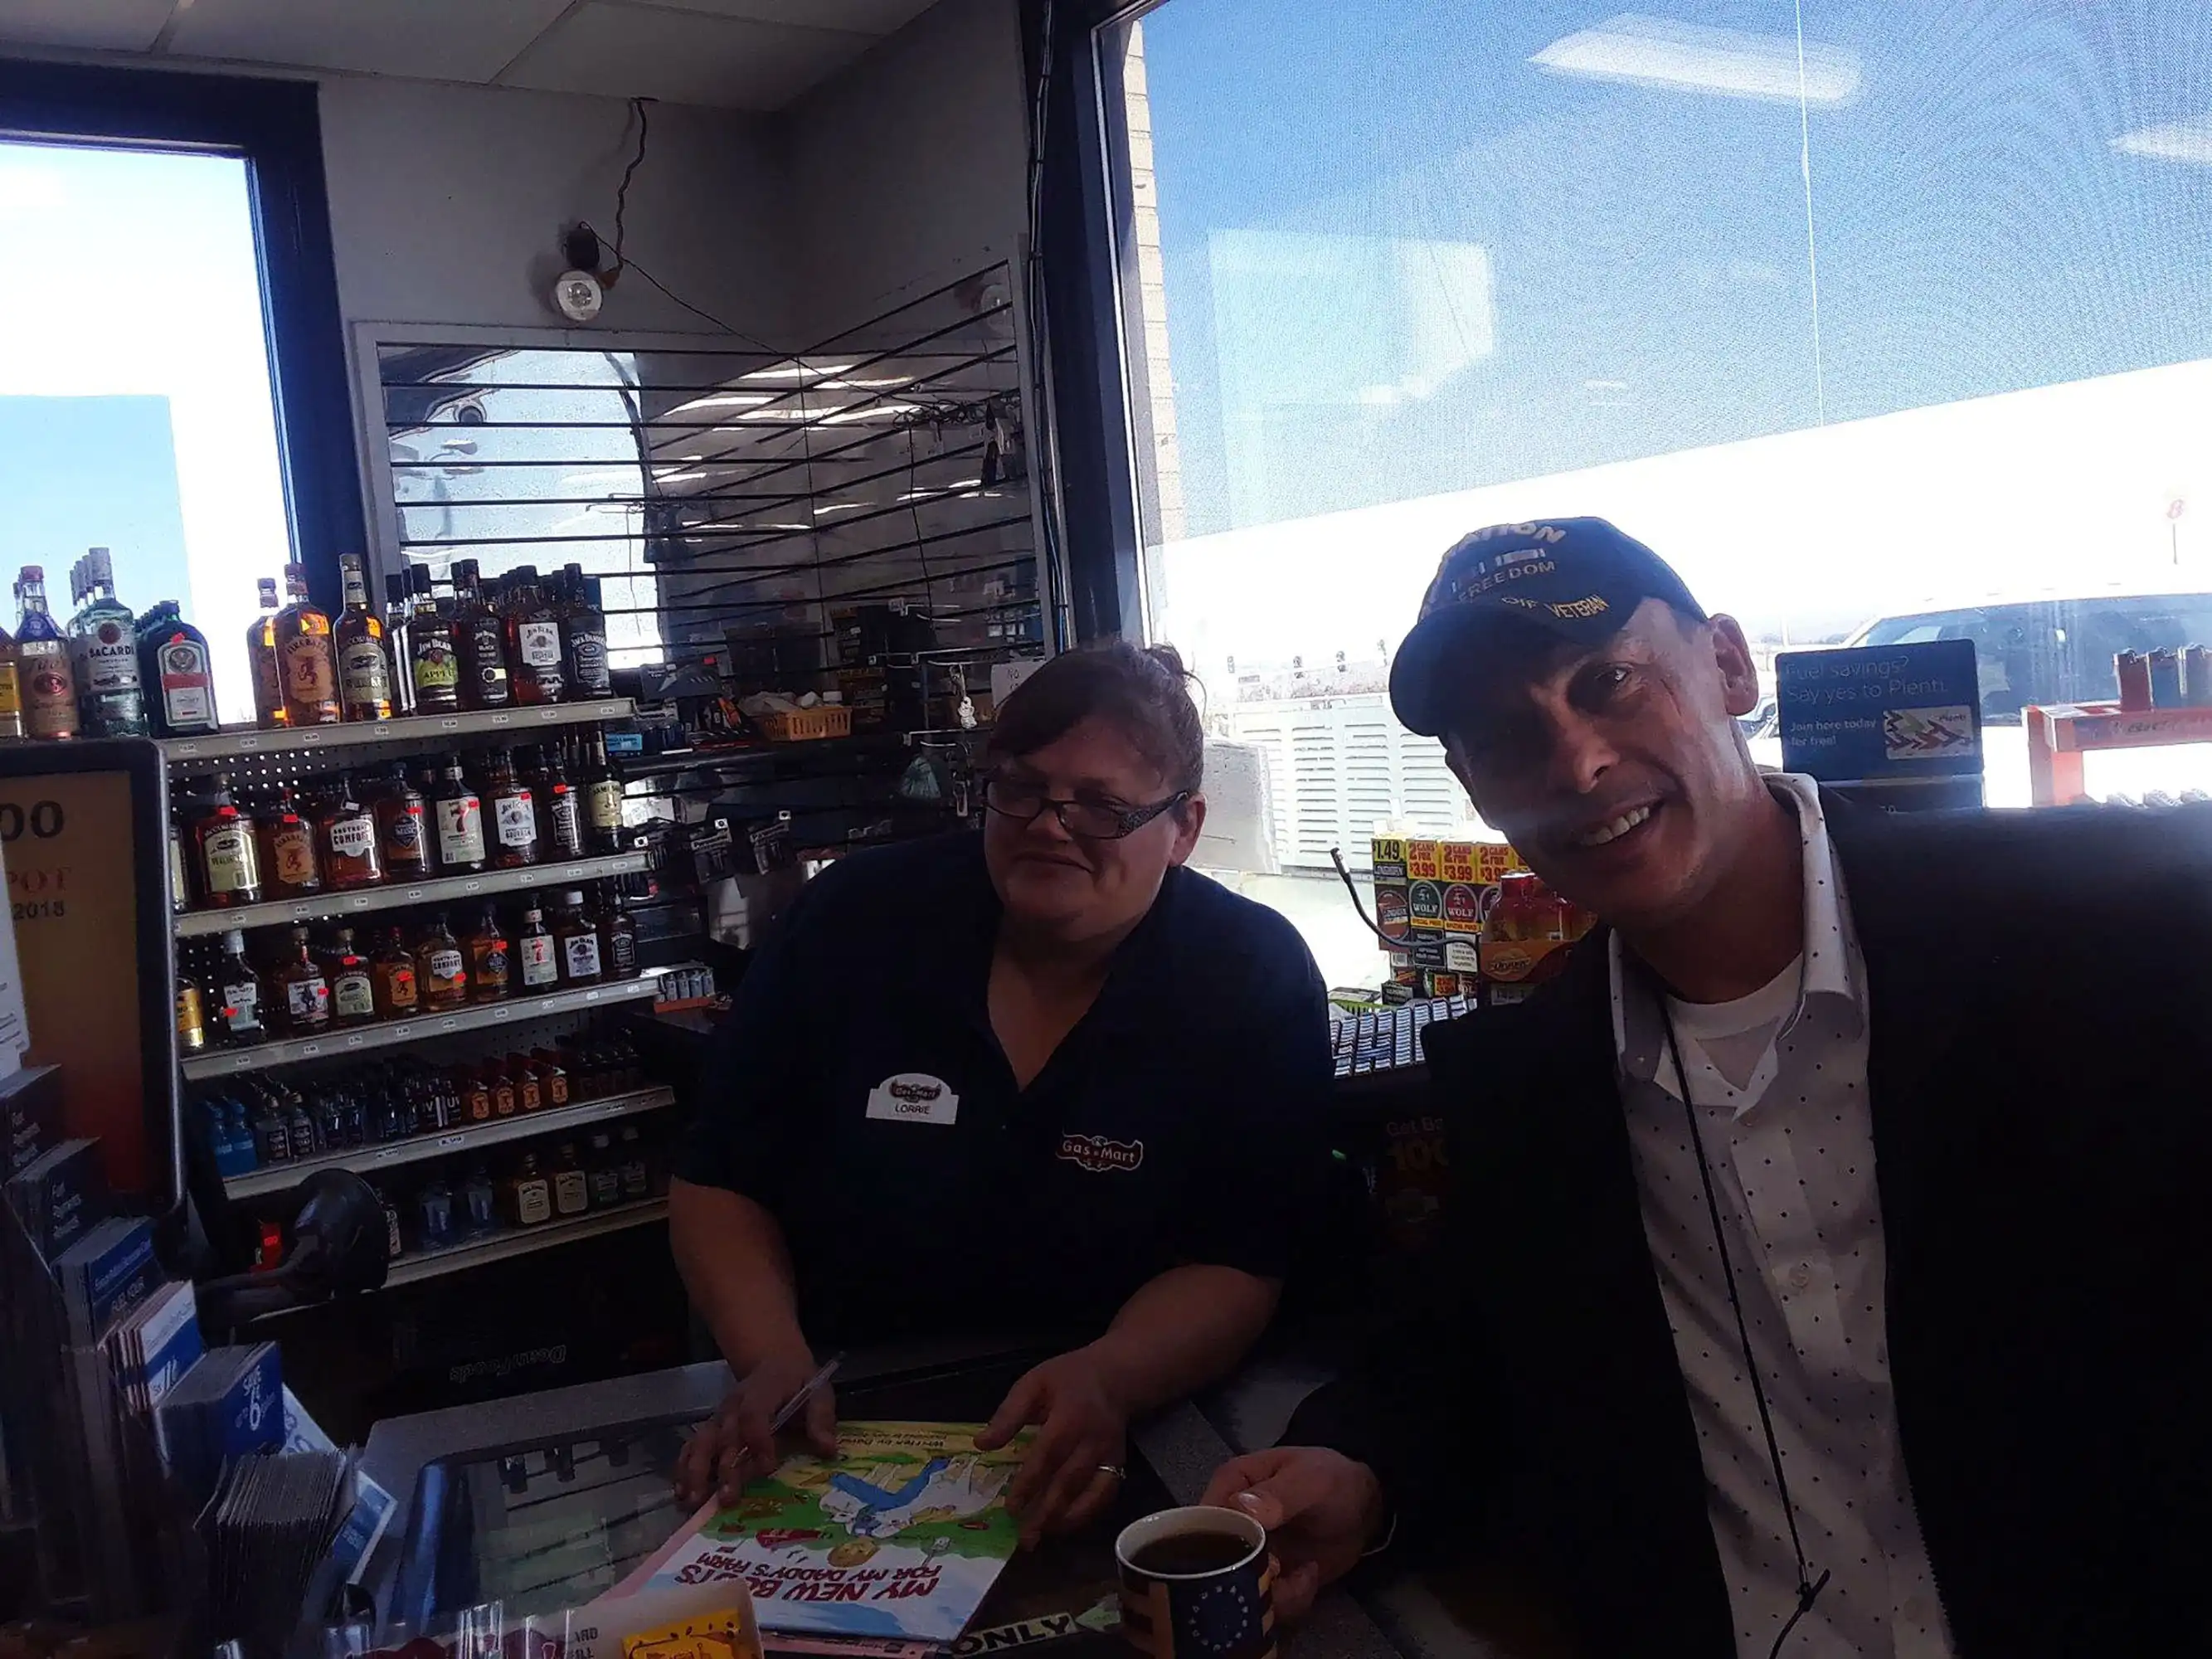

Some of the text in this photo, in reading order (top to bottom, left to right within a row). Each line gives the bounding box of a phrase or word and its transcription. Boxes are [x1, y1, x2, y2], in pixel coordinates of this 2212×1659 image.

[1458, 560, 1556, 603] FREEDOM
[1544, 594, 1609, 618] VETERAN
[89, 645, 134, 658] BACARDI
[418, 640, 432, 654] JIM
[1786, 654, 1910, 679] Fuel savings?
[1787, 685, 1821, 705] Say
[1825, 686, 1858, 704] yes
[1863, 682, 1883, 698] to
[1790, 717, 1877, 732] Join here today
[1791, 734, 1837, 748] for free!
[450, 805, 469, 833] 7
[333, 832, 371, 845] COMFORT
[1373, 840, 1399, 860] $1.49
[1409, 843, 1436, 860] 2 CANS
[1417, 851, 1432, 861] FOR
[1444, 846, 1472, 863] 2 CANS
[1480, 846, 1509, 864] 2 CANS
[1453, 854, 1468, 864] FOR
[1490, 855, 1505, 865] FOR
[1410, 861, 1436, 878] $3.99
[1444, 865, 1473, 881] $3.99
[12, 899, 65, 920] 2018
[1412, 903, 1438, 914] WOLF
[1447, 907, 1474, 918] WOLF
[895, 1104, 931, 1115] LORRIE
[1062, 1140, 1135, 1164] Gas Mart
[695, 1551, 942, 1583] FOR MY DADDY'S FARM
[785, 1581, 869, 1602] NEW
[873, 1577, 940, 1600] MY
[951, 1613, 1071, 1657] ONLY
